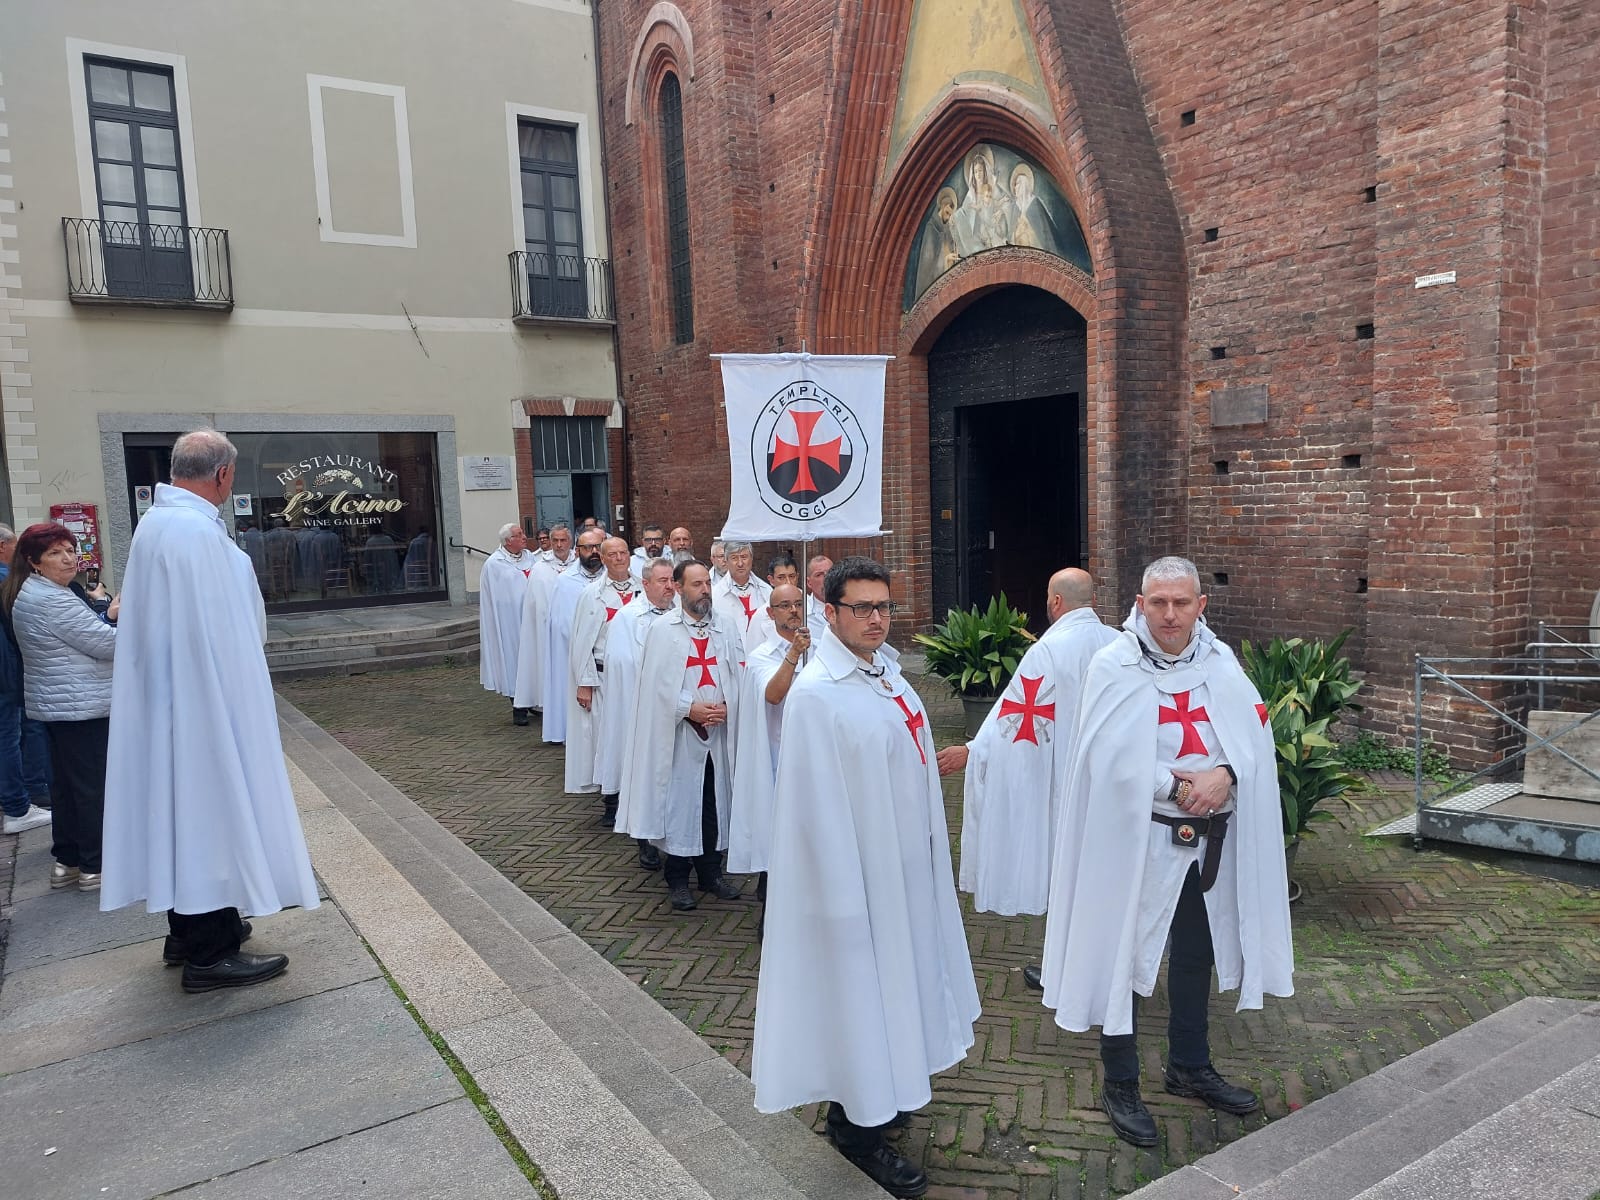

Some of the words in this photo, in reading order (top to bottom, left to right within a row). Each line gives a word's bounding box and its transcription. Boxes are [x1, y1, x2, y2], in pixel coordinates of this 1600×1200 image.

[768, 386, 849, 423] TEMPLARI
[276, 454, 399, 486] RESTAURANT
[269, 489, 410, 522] L'Acino
[303, 518, 331, 527] WINE
[333, 516, 384, 527] GALLERY
[781, 500, 827, 518] OGGI
